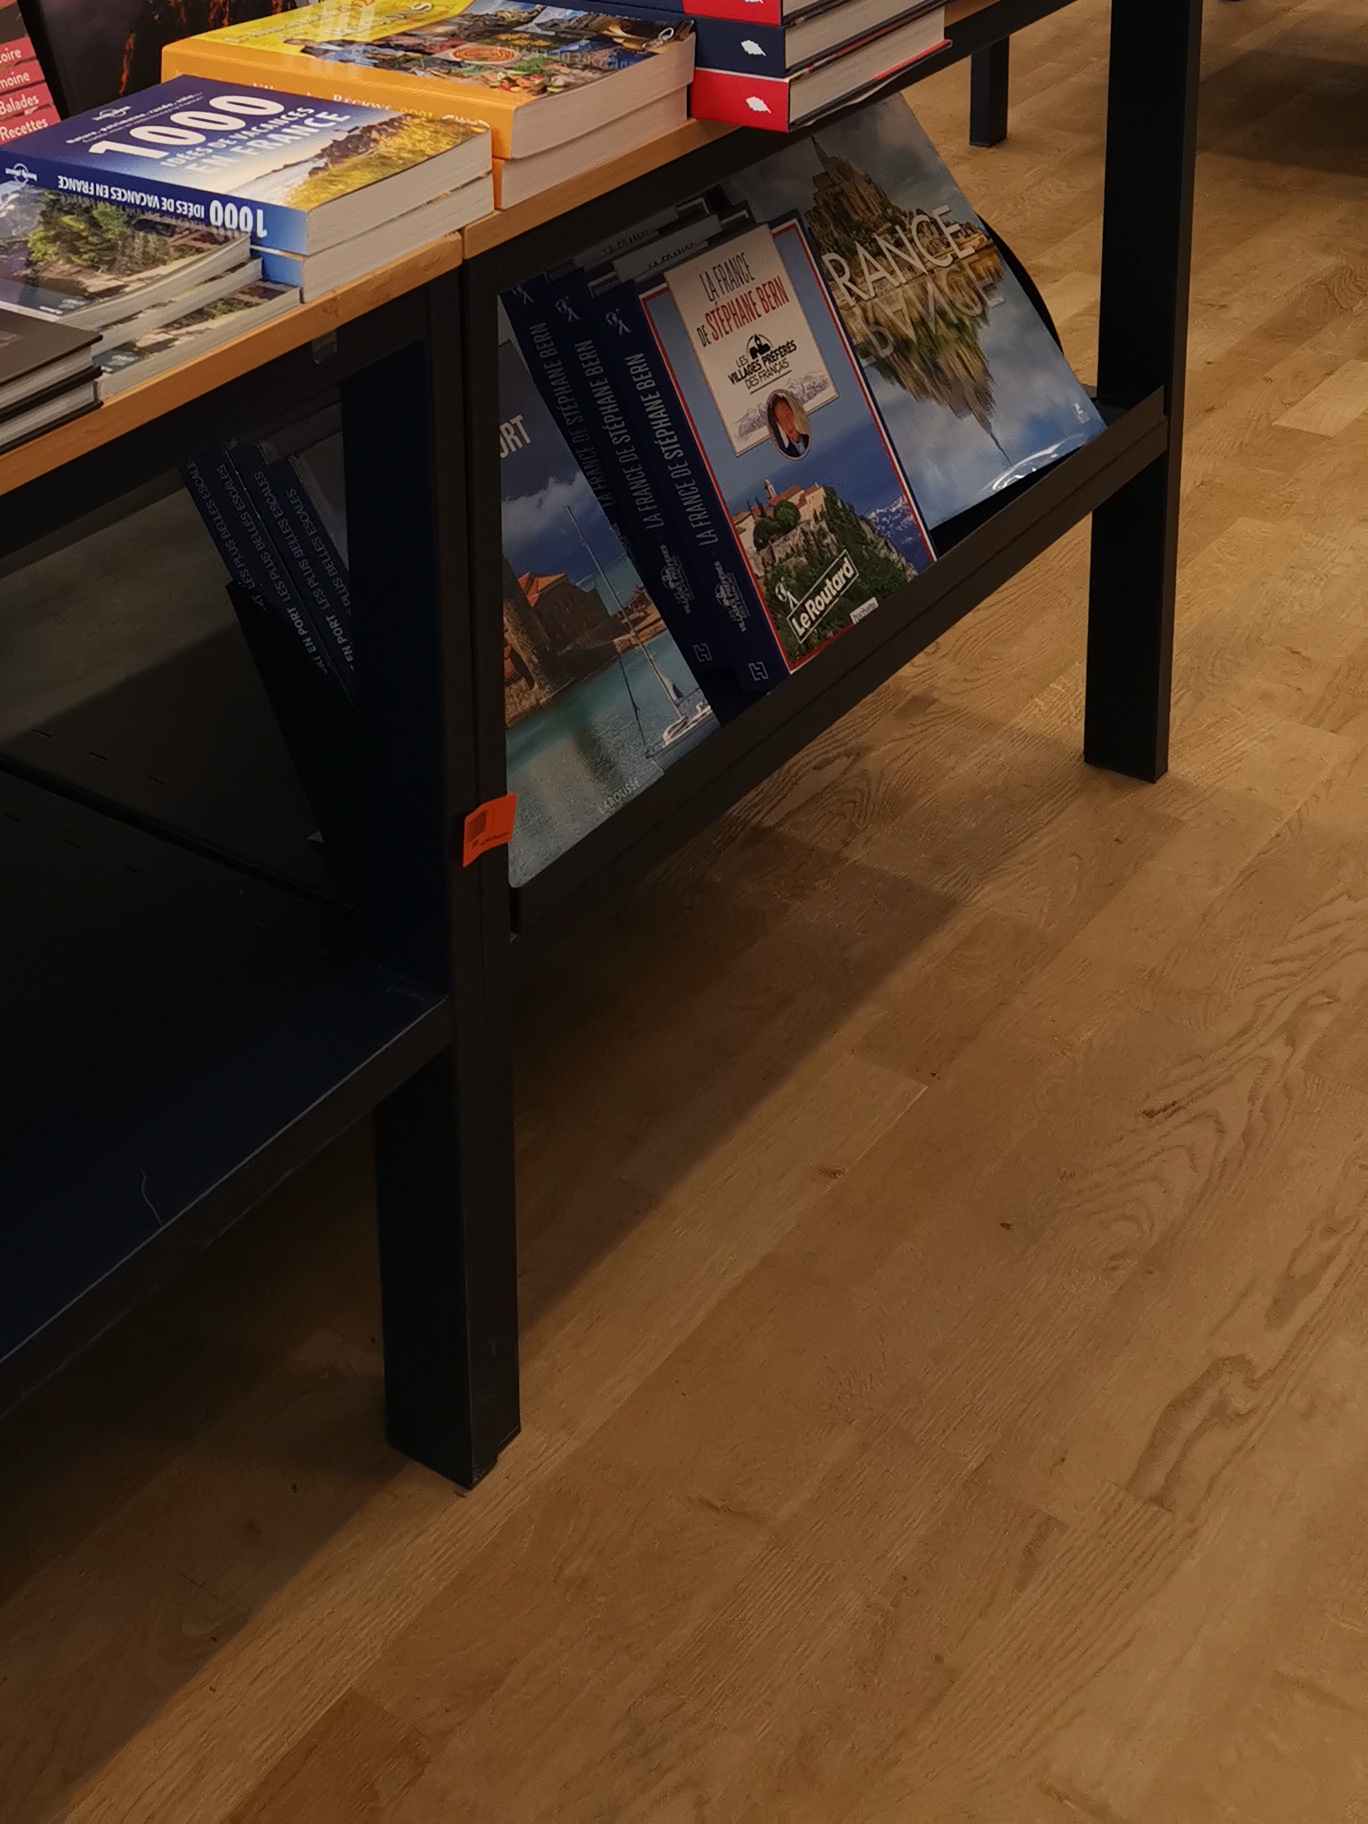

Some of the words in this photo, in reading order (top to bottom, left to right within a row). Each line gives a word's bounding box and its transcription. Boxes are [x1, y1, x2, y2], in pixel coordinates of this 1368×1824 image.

[88, 94, 286, 160] 1000
[231, 106, 316, 141] VACANCES
[57, 174, 95, 195] FRANCE
[109, 185, 161, 211] VACANCES
[175, 202, 206, 221] IDÉES
[209, 199, 269, 239] 1000
[715, 252, 757, 294] FRANCE
[706, 287, 763, 342] STÉPHANE
[756, 275, 790, 318] BERN
[625, 352, 656, 393] BERN
[640, 391, 685, 462] STÉPHANE
[675, 479, 712, 529] FRANCE
